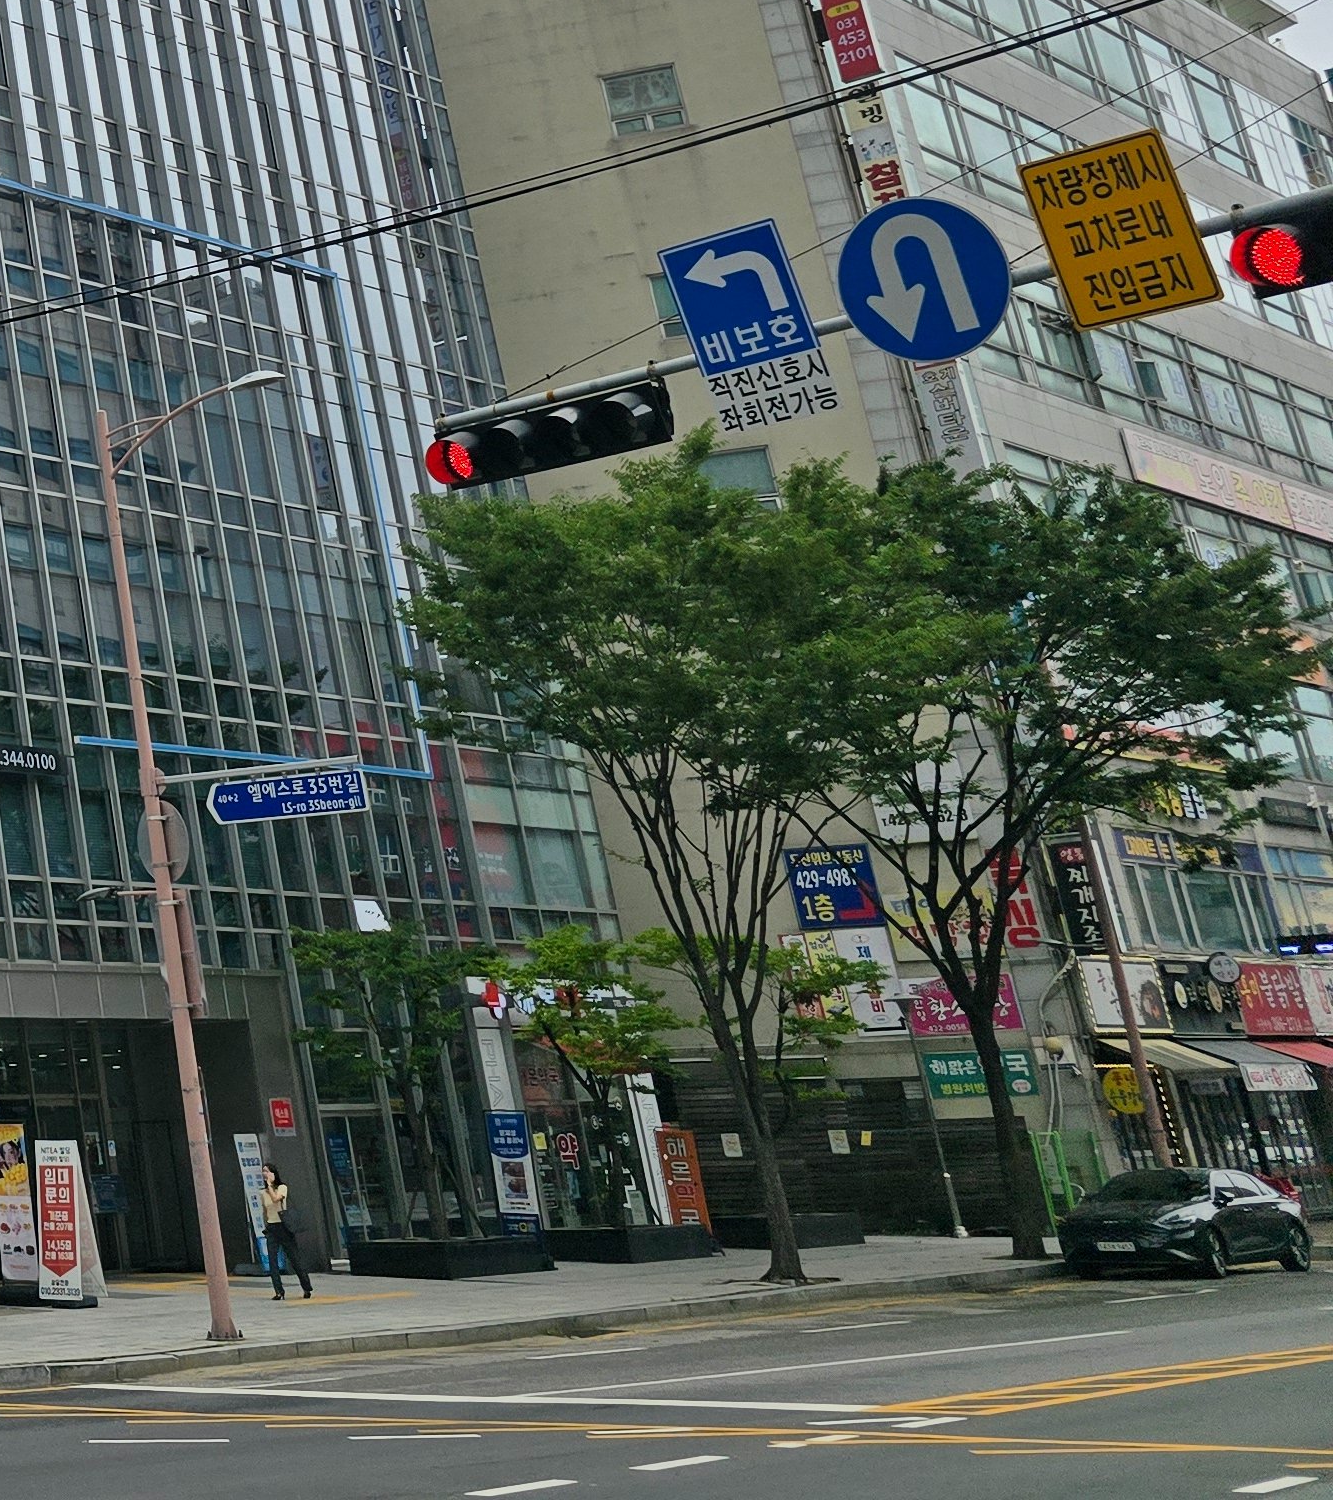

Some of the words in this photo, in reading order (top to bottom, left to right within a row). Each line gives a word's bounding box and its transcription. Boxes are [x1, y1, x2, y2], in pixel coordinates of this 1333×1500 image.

[836, 16, 859, 31] 031
[837, 29, 867, 46] 453
[838, 45, 874, 65] 2101
[1033, 144, 1166, 211] 차량정체시
[1064, 199, 1174, 258] 교차로내
[1083, 253, 1195, 312] 진입금지
[700, 313, 804, 364] 비보호
[707, 349, 831, 400] 직진신호시
[719, 383, 838, 432] 좌회전가능
[282, 801, 307, 814] LS-ro
[308, 795, 363, 812] 35beon-gil
[802, 893, 835, 921] 1층
[928, 1053, 1031, 1077] 해맑은국
[44, 1168, 70, 1185] 임대
[44, 1187, 70, 1204] 문의
